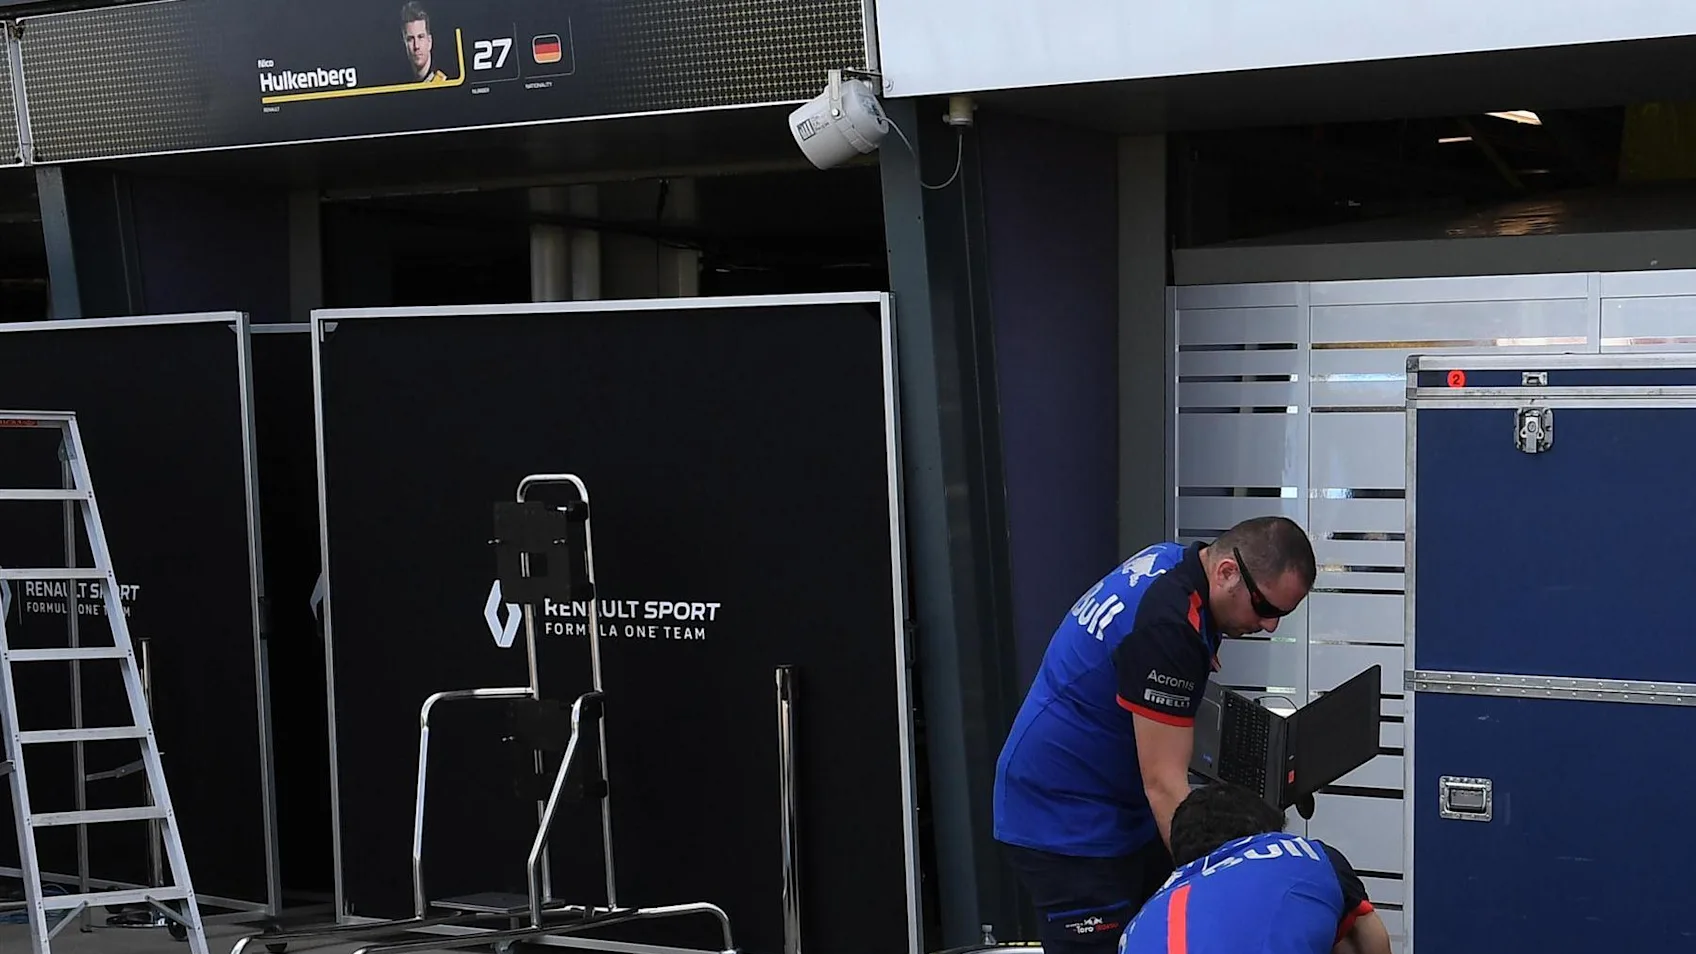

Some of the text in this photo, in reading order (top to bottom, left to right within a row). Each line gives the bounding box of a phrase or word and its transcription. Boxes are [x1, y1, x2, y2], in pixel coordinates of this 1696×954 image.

[257, 58, 275, 68] Nico
[473, 38, 513, 71] 27
[259, 66, 357, 93] Hulkenberg
[1452, 373, 1461, 386] 2
[90, 583, 140, 602] SRT
[77, 604, 101, 616] ONE
[643, 600, 721, 621] SPORT
[545, 622, 706, 641] FORMLA ONE TEAM
[1147, 668, 1195, 692] Acronis
[1143, 687, 1191, 709] PIRELLI
[1076, 925, 1095, 935] Toro
